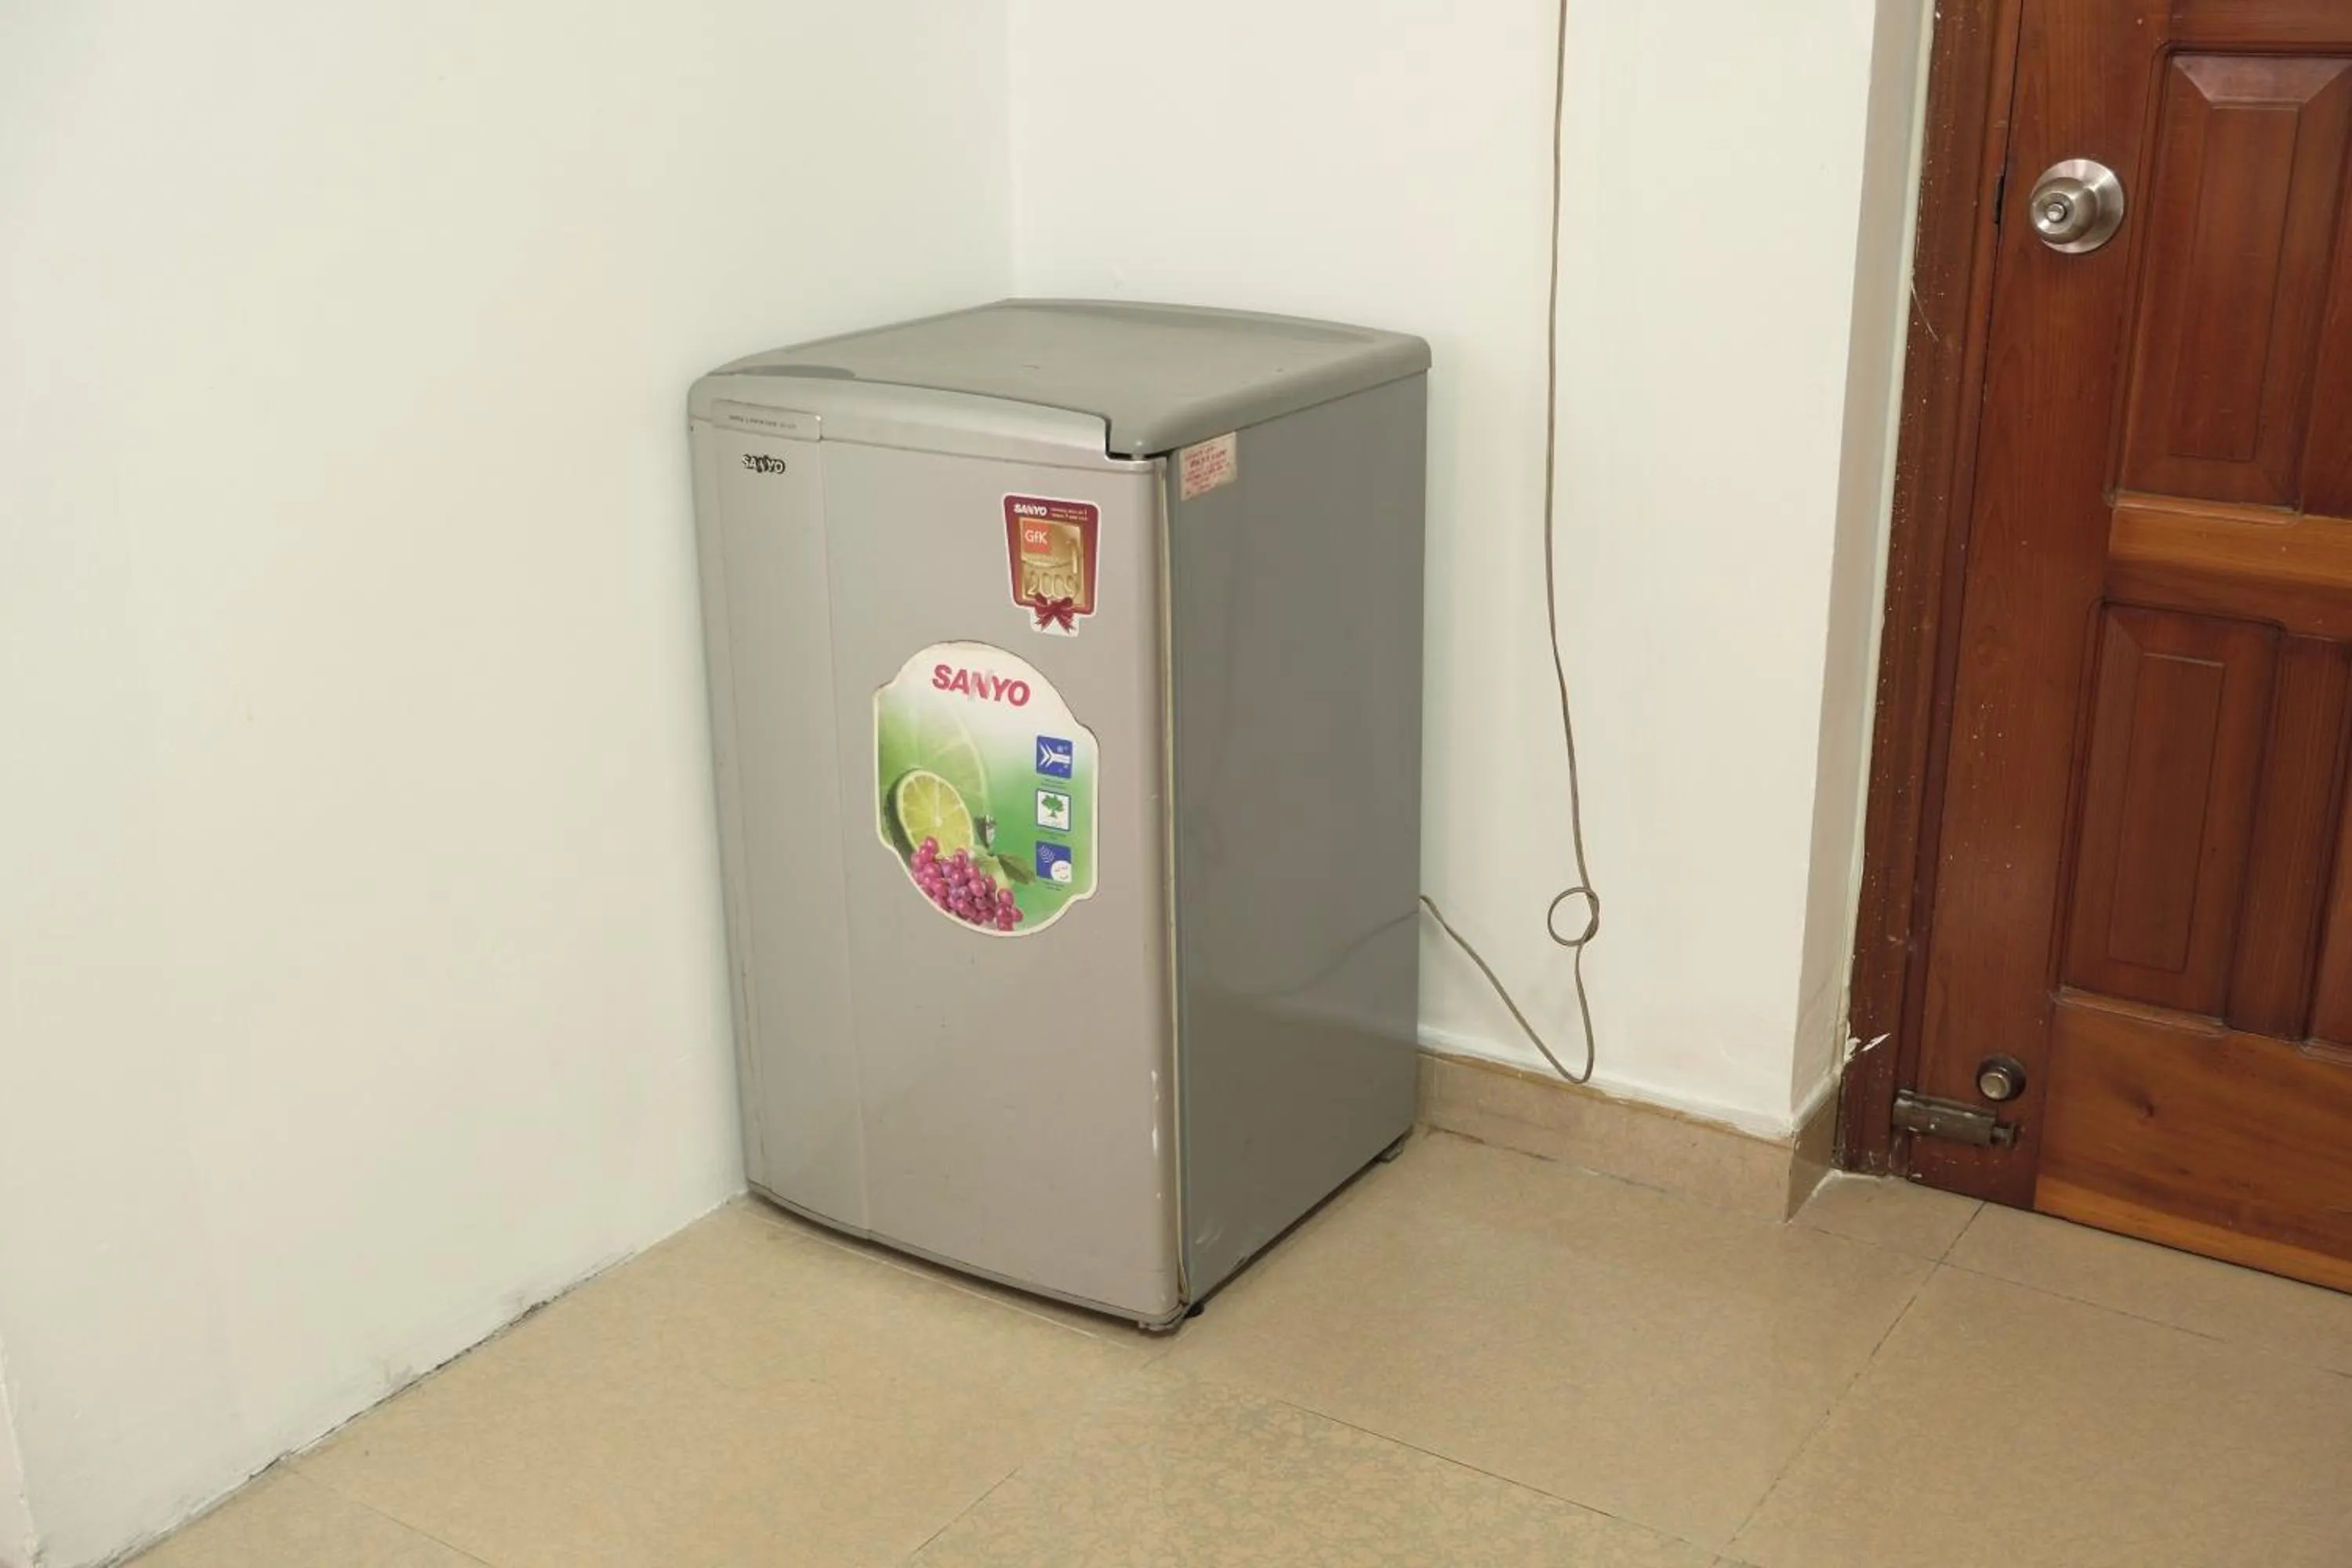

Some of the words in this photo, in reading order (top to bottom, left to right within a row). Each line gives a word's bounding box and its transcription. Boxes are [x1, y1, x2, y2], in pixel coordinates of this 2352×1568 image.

[742, 453, 786, 474] SANYO
[1014, 504, 1047, 517] SANYO
[932, 664, 1031, 707] SANYO
